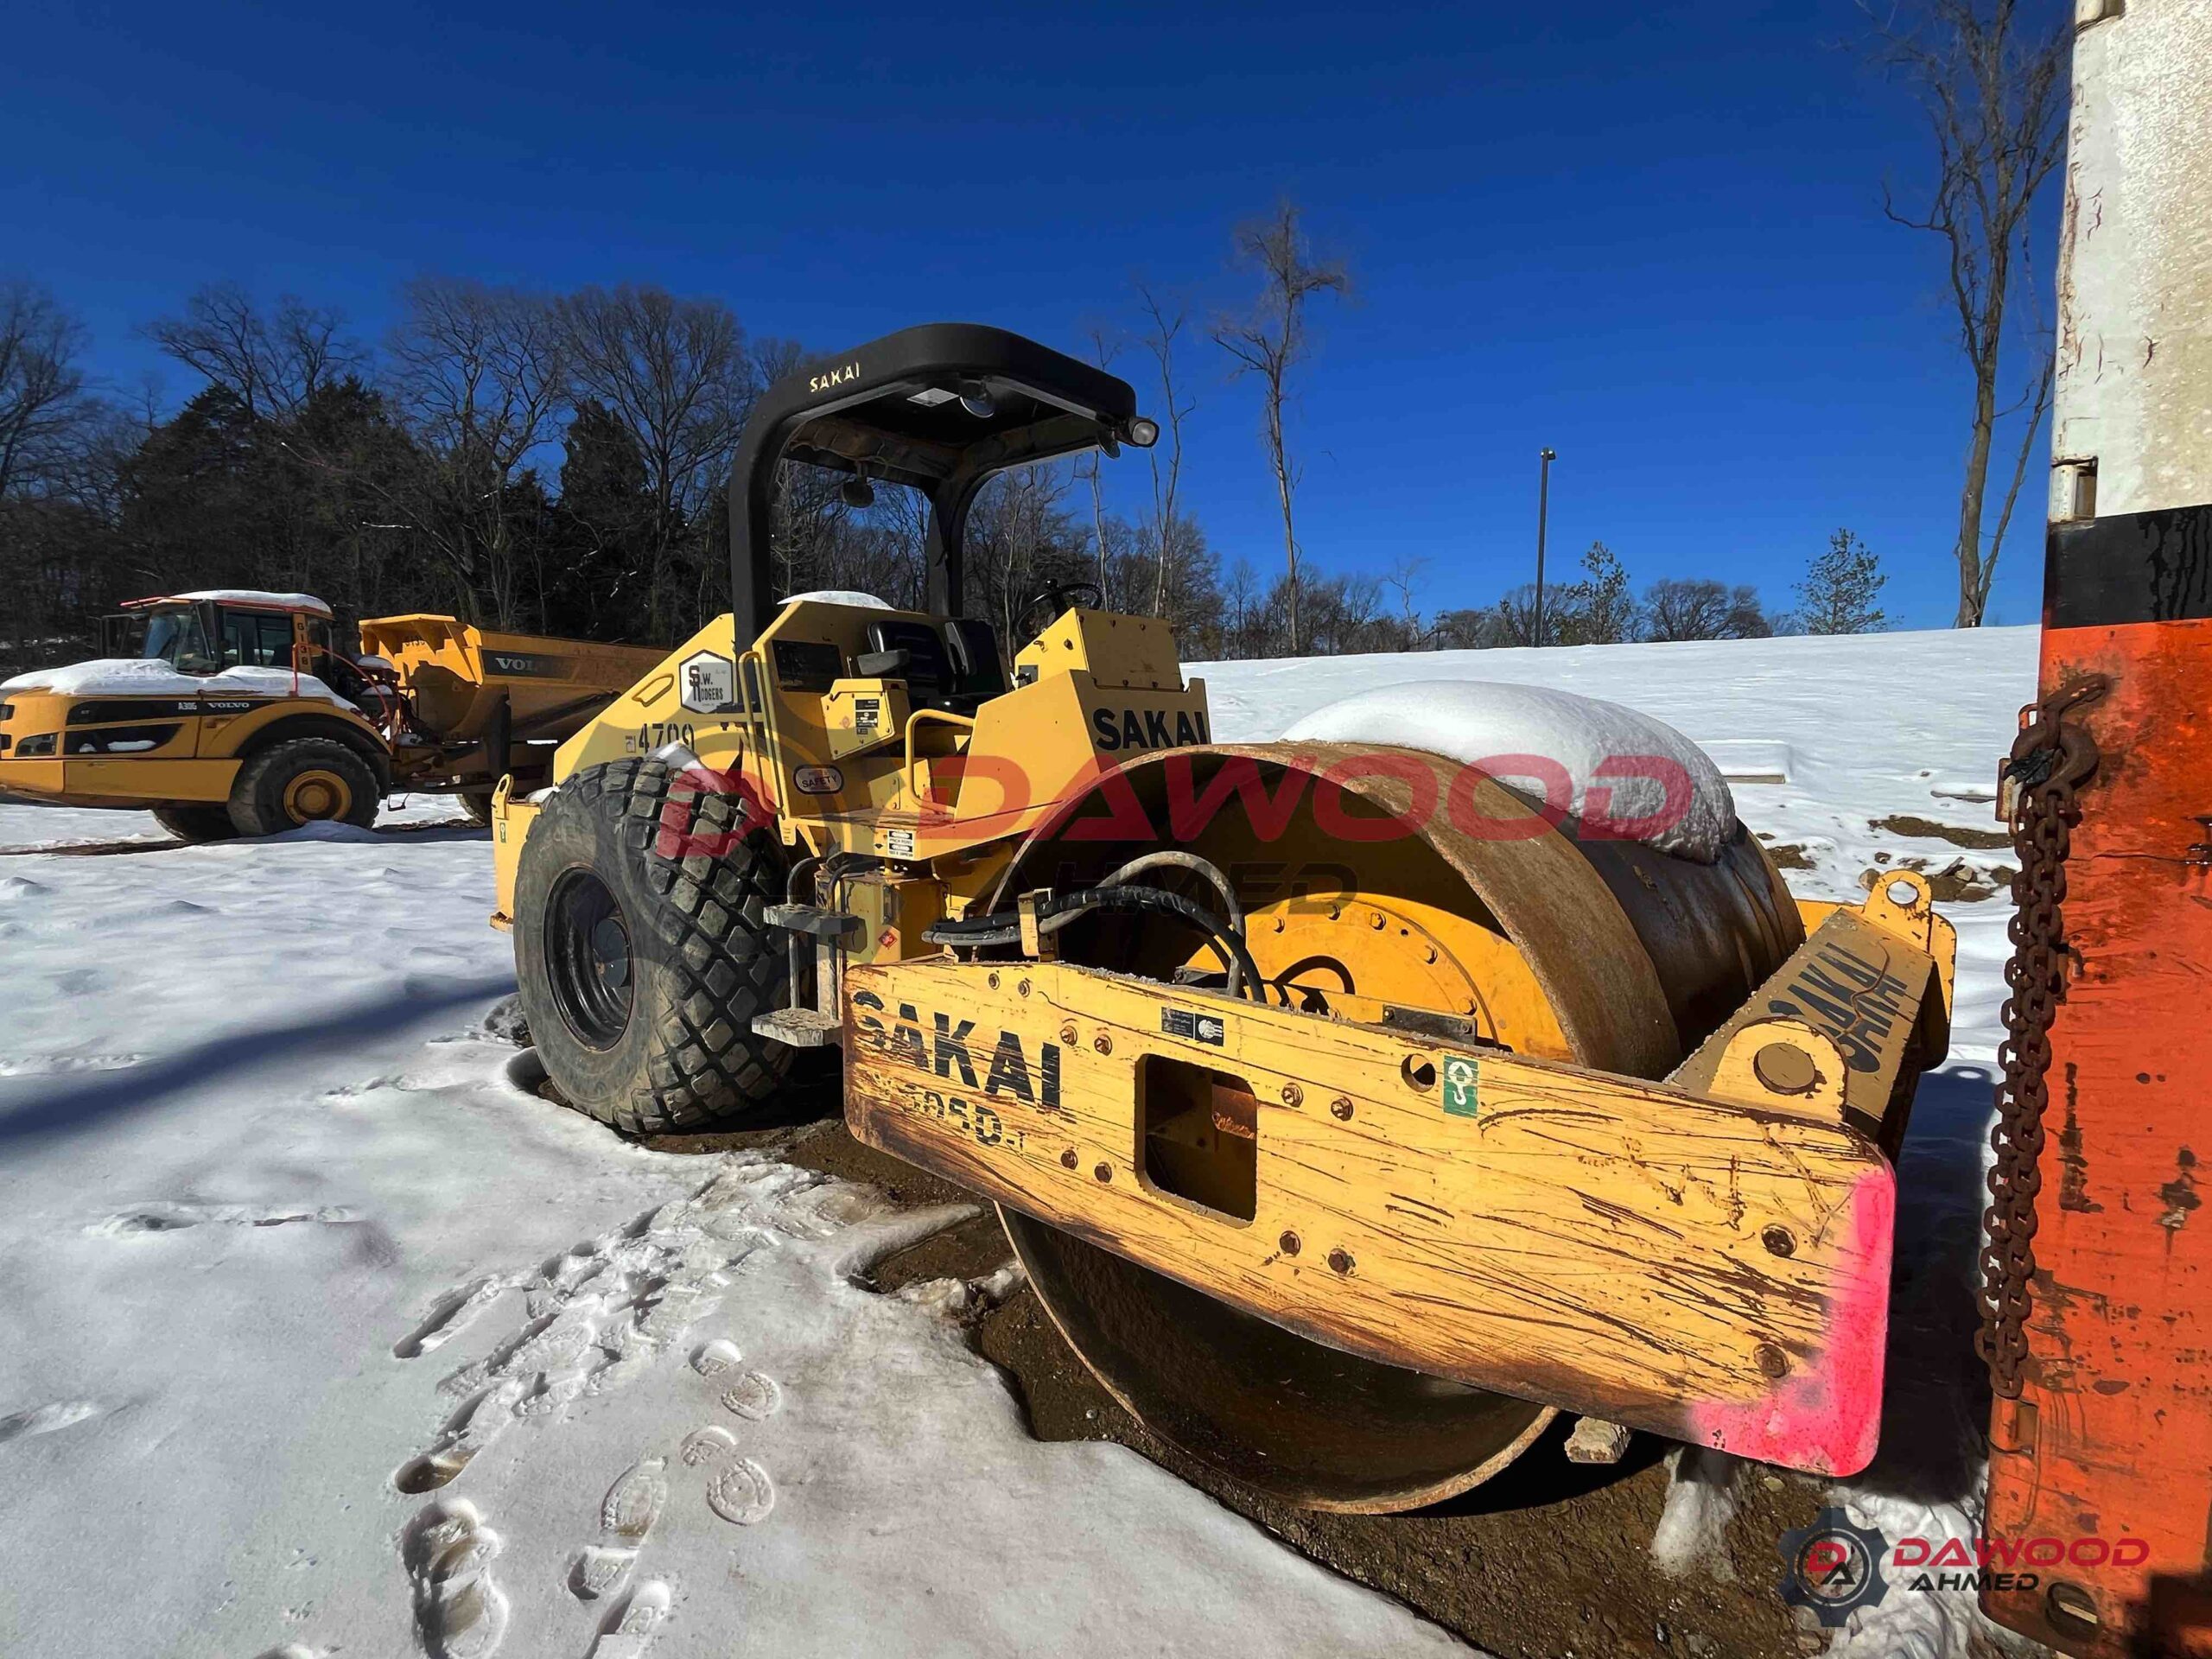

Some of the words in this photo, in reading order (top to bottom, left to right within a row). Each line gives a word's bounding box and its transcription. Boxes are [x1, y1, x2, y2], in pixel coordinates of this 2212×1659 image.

[809, 361, 860, 392] SAKAI
[639, 723, 695, 753] 4709
[1092, 708, 1208, 751] SAKAI
[801, 774, 838, 788] SAFETY
[1768, 942, 1908, 1073] SAKAI
[853, 990, 1060, 1109] SAKAI
